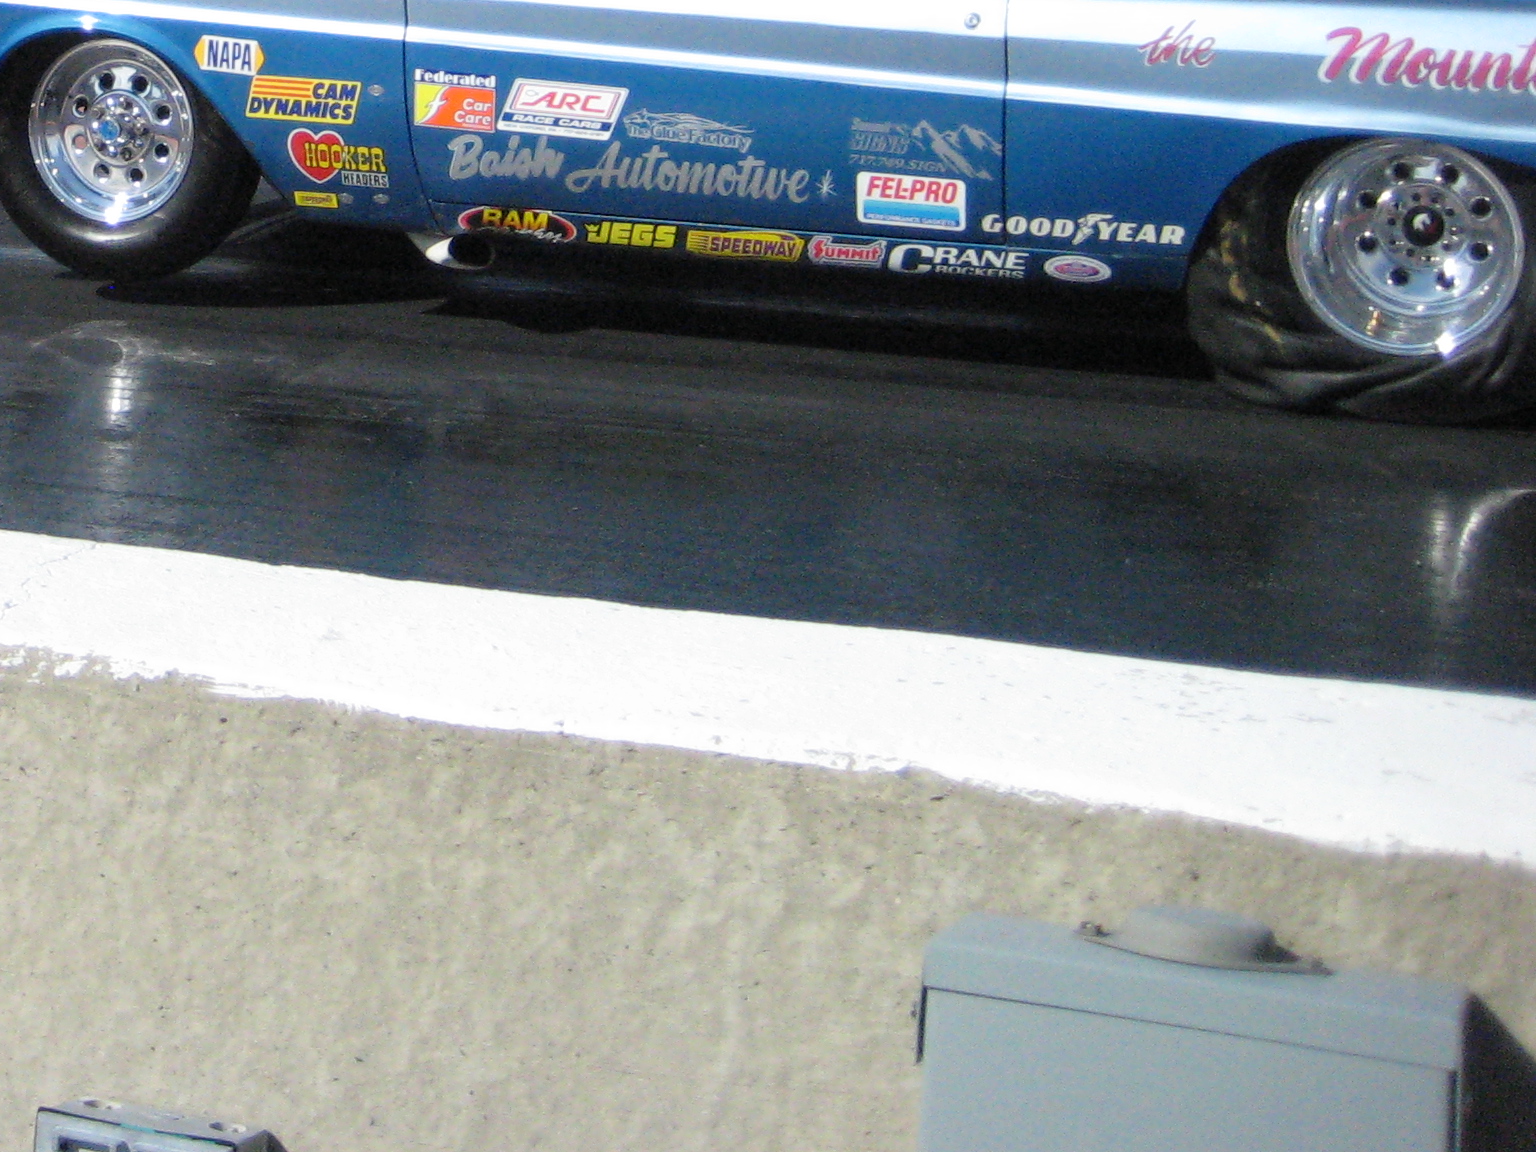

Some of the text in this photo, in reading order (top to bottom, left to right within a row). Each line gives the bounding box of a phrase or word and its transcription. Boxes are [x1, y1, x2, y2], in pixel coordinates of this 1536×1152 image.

[206, 38, 252, 72] NAPA
[1137, 19, 1536, 97] the Mount
[414, 68, 496, 88] Federated
[313, 82, 357, 102] CAM
[519, 91, 606, 114] ARC
[248, 96, 354, 121] DYNAMICS
[462, 98, 492, 112] Car
[453, 110, 492, 125] Care
[512, 113, 602, 130] RACE CARS
[304, 142, 387, 173] HOOKER
[343, 173, 388, 188] HEADERS
[565, 140, 810, 204] Automotive
[866, 175, 958, 204] FEL-PRO
[482, 208, 549, 231] RAM
[586, 221, 678, 249] JEGS
[709, 235, 797, 258] SPEEDWAY
[888, 243, 1029, 275] CRANE
[935, 264, 1025, 279] ROCKERS
